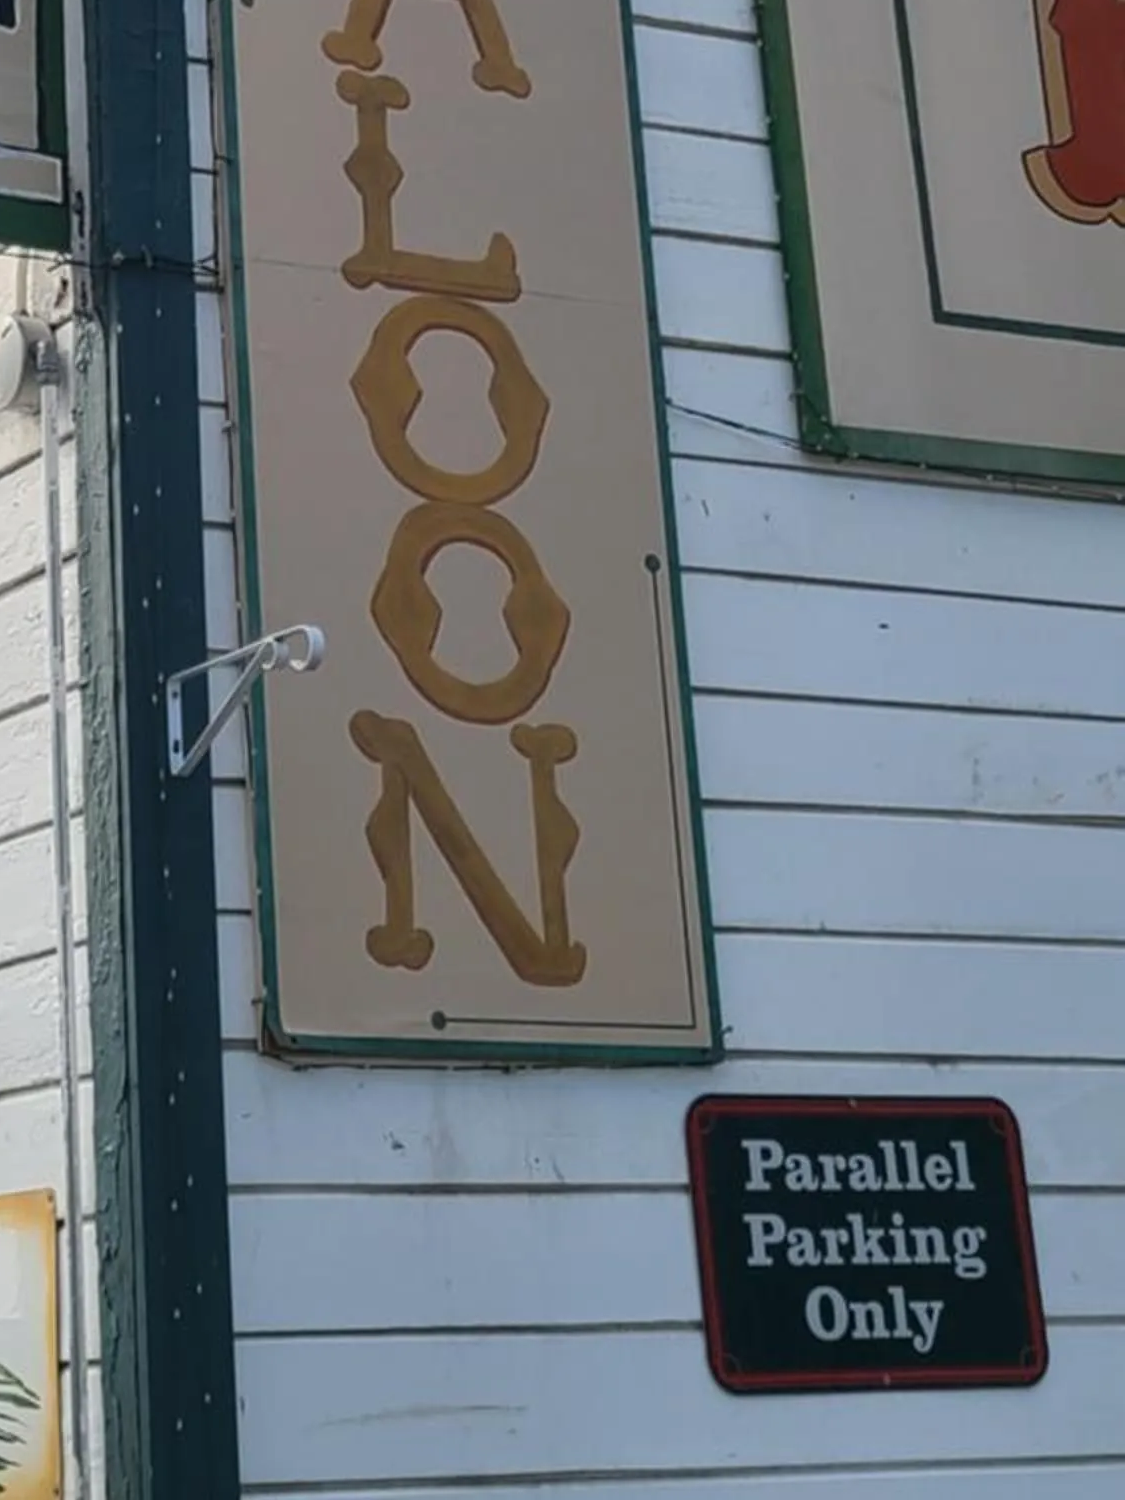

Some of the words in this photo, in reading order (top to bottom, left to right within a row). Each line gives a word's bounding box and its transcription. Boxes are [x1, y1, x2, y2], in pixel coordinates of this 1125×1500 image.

[741, 1139, 975, 1191] Parallel
[743, 1212, 987, 1278] Parking
[805, 1286, 944, 1353] Only
